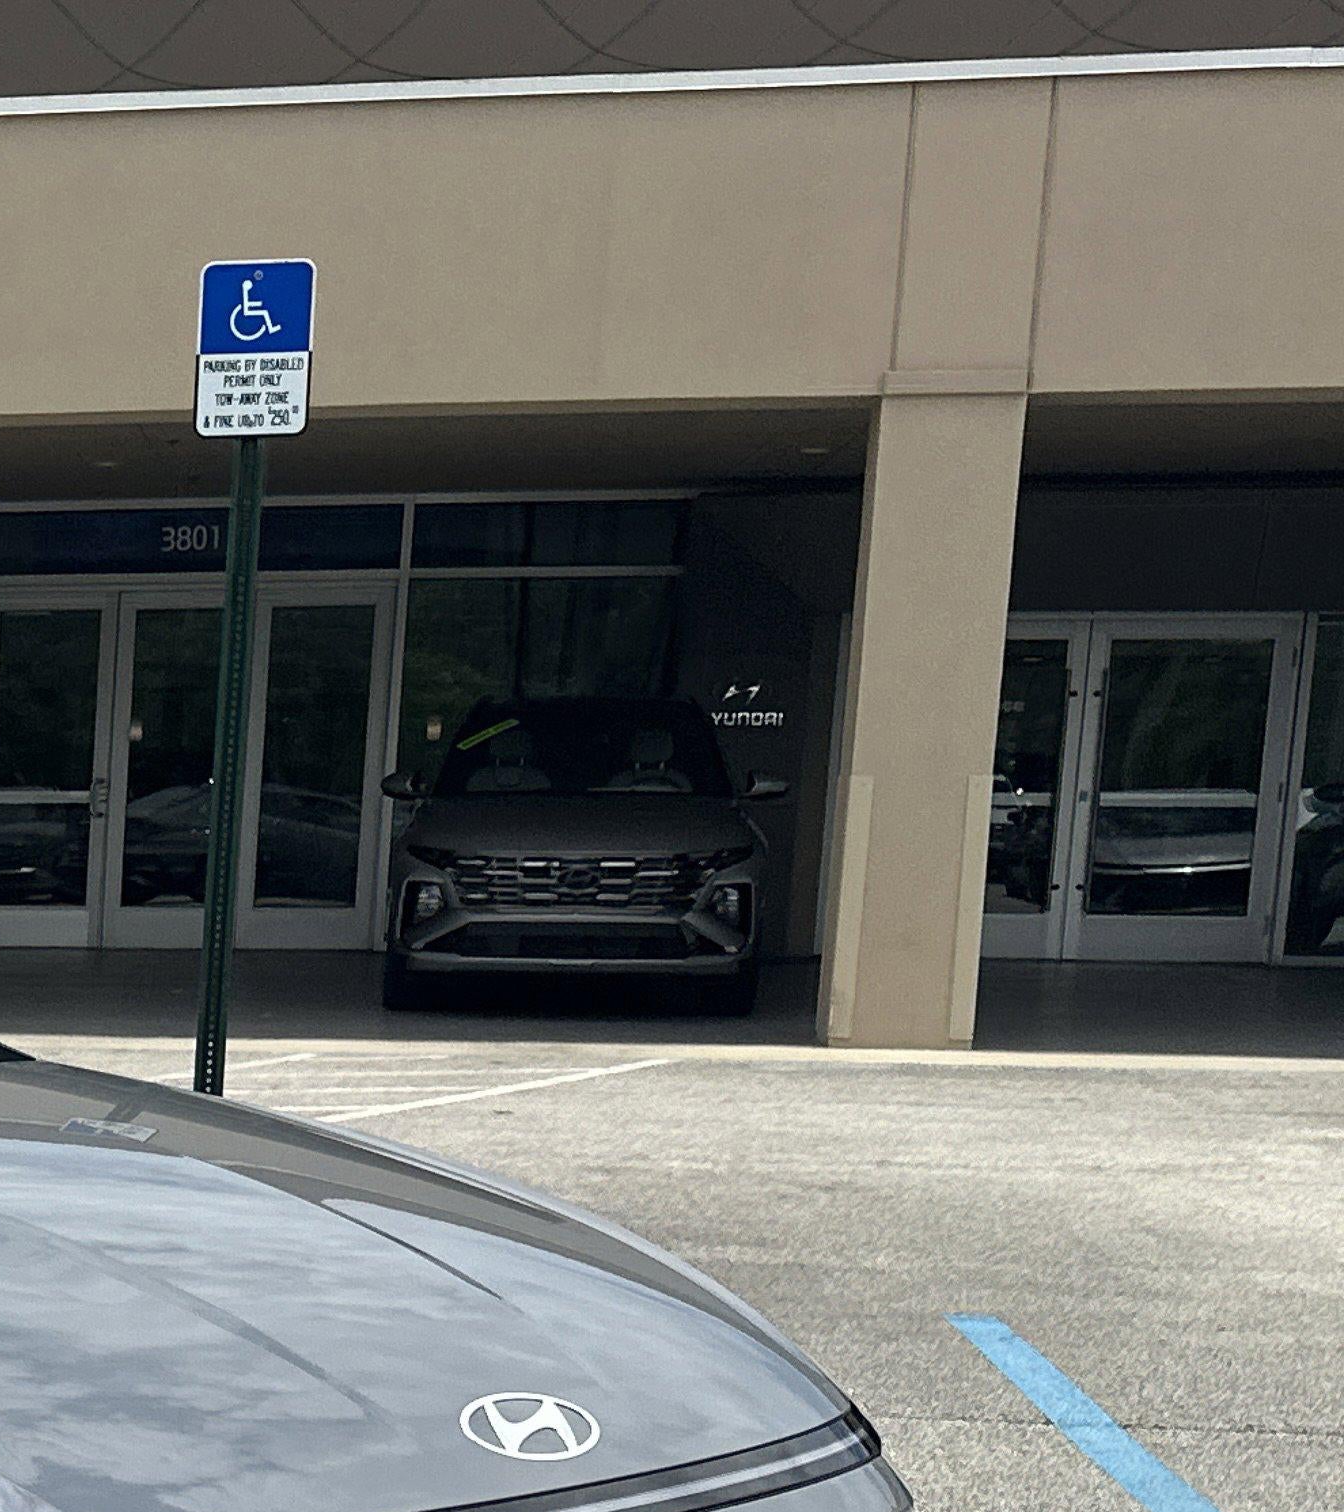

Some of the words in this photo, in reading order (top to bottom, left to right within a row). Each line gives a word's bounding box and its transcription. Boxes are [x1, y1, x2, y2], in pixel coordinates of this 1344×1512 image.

[203, 360, 242, 373] PARKING
[244, 359, 257, 371] BY
[259, 357, 305, 371] DISABLED
[223, 374, 257, 387] PERMIT
[259, 373, 283, 387] ONLY
[265, 391, 290, 405] ZONE
[160, 525, 222, 552] 3801
[710, 711, 785, 727] YUNDAI
